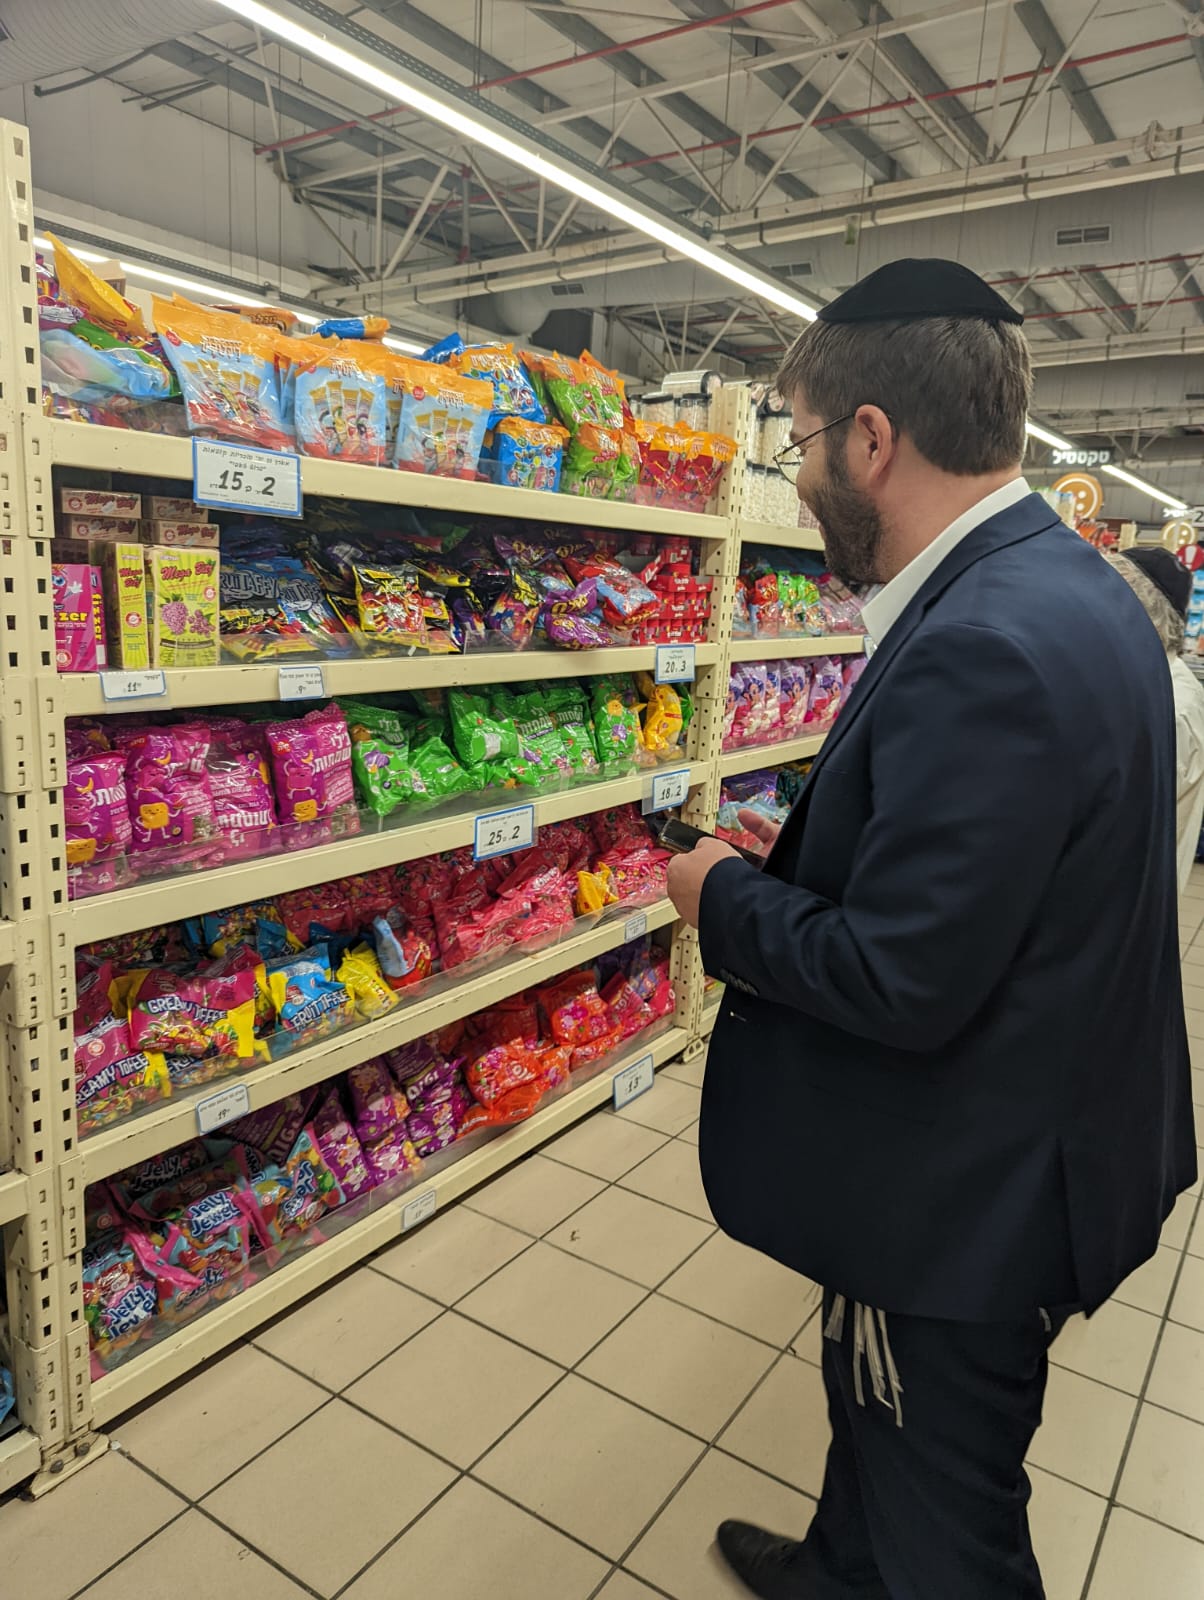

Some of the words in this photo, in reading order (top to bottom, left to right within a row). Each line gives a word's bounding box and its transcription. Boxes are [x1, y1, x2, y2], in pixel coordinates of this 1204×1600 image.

[1052, 449, 1110, 466] טקסטיל
[218, 469, 244, 491] 15
[261, 476, 276, 497] 2
[161, 565, 192, 582] Mega
[664, 660, 676, 674] 20
[659, 787, 671, 801] 18
[674, 784, 683, 798] 2
[487, 829, 503, 847] 25
[511, 824, 521, 840] 2
[76, 1065, 116, 1106] REAMY
[189, 1190, 228, 1220] Jelly
[108, 1284, 147, 1327] Jelly
